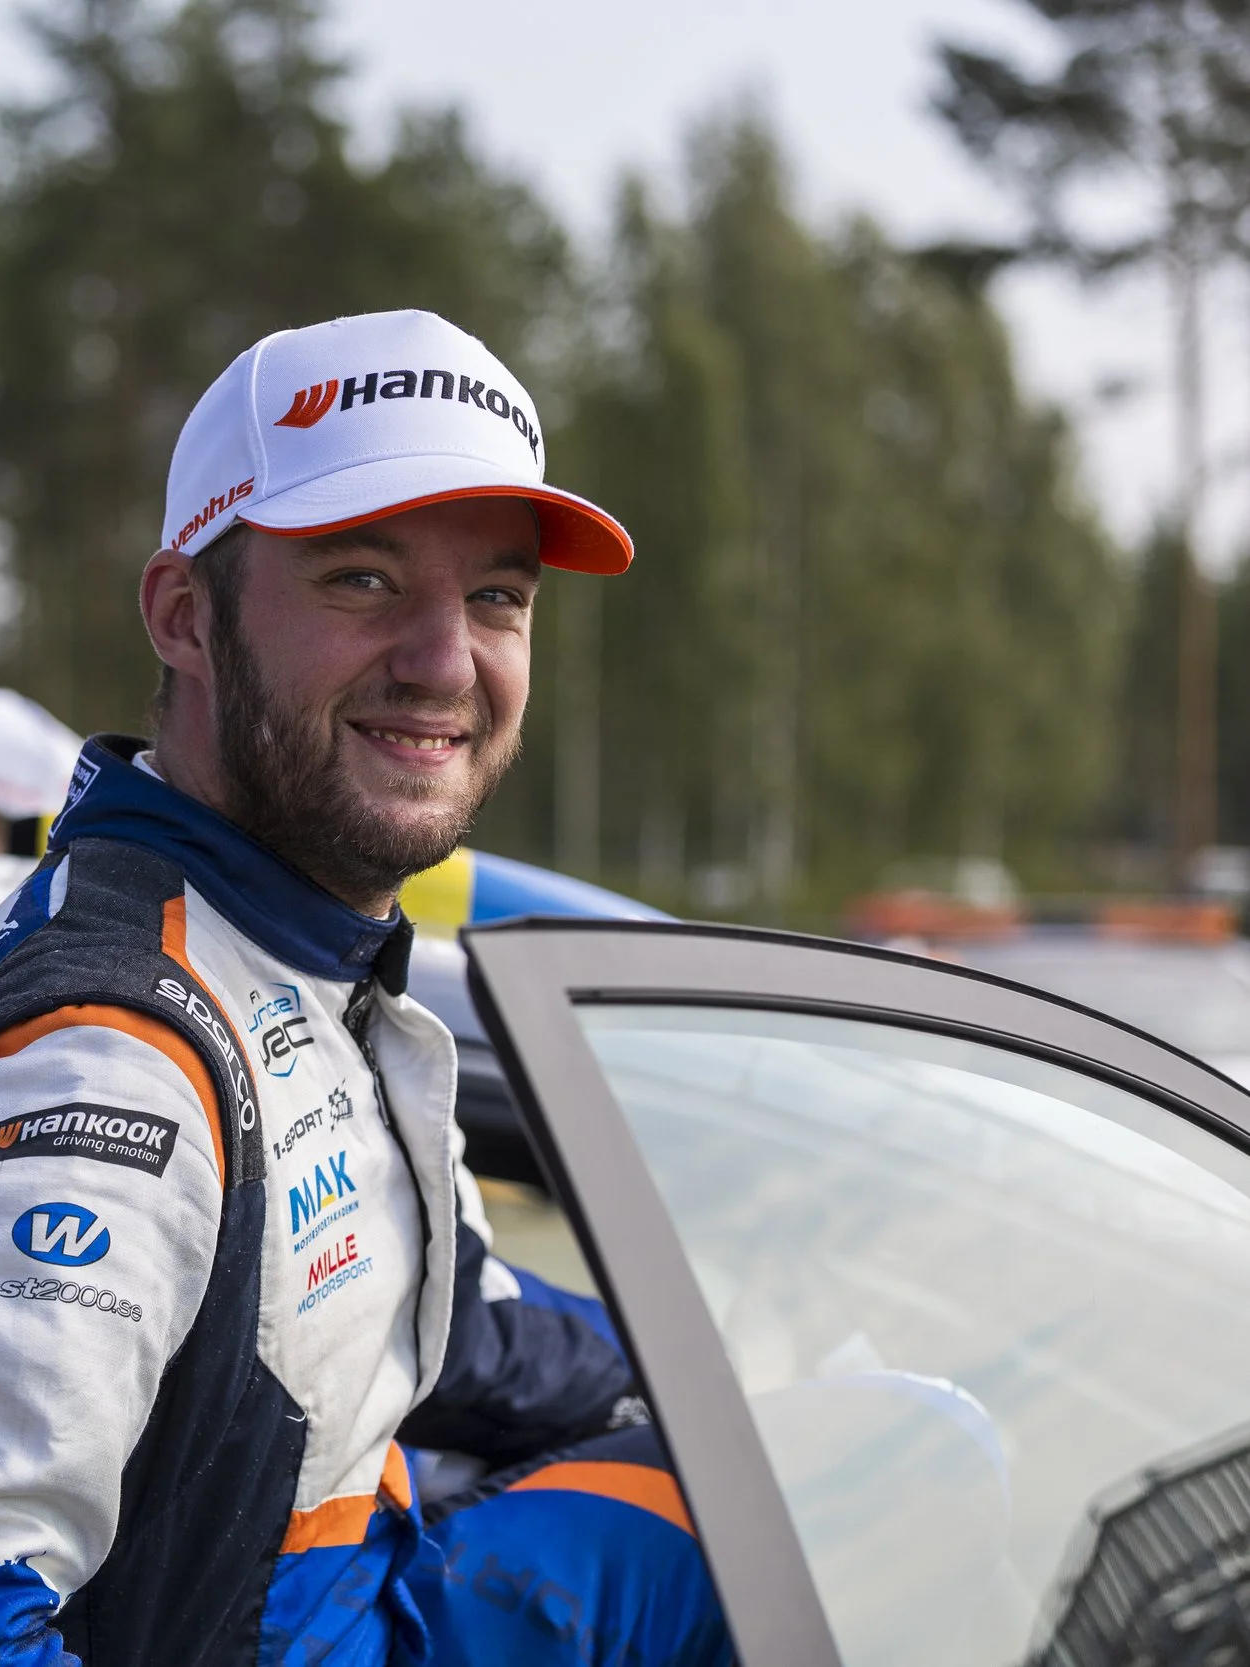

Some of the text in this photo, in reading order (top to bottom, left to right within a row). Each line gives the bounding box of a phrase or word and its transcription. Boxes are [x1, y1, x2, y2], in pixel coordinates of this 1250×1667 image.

[155, 977, 256, 1132] sparco
[53, 1133, 160, 1165] driving emotion
[289, 1150, 357, 1235] MAK
[296, 1257, 374, 1318] MOTORSPORT
[308, 1233, 359, 1291] MILLE
